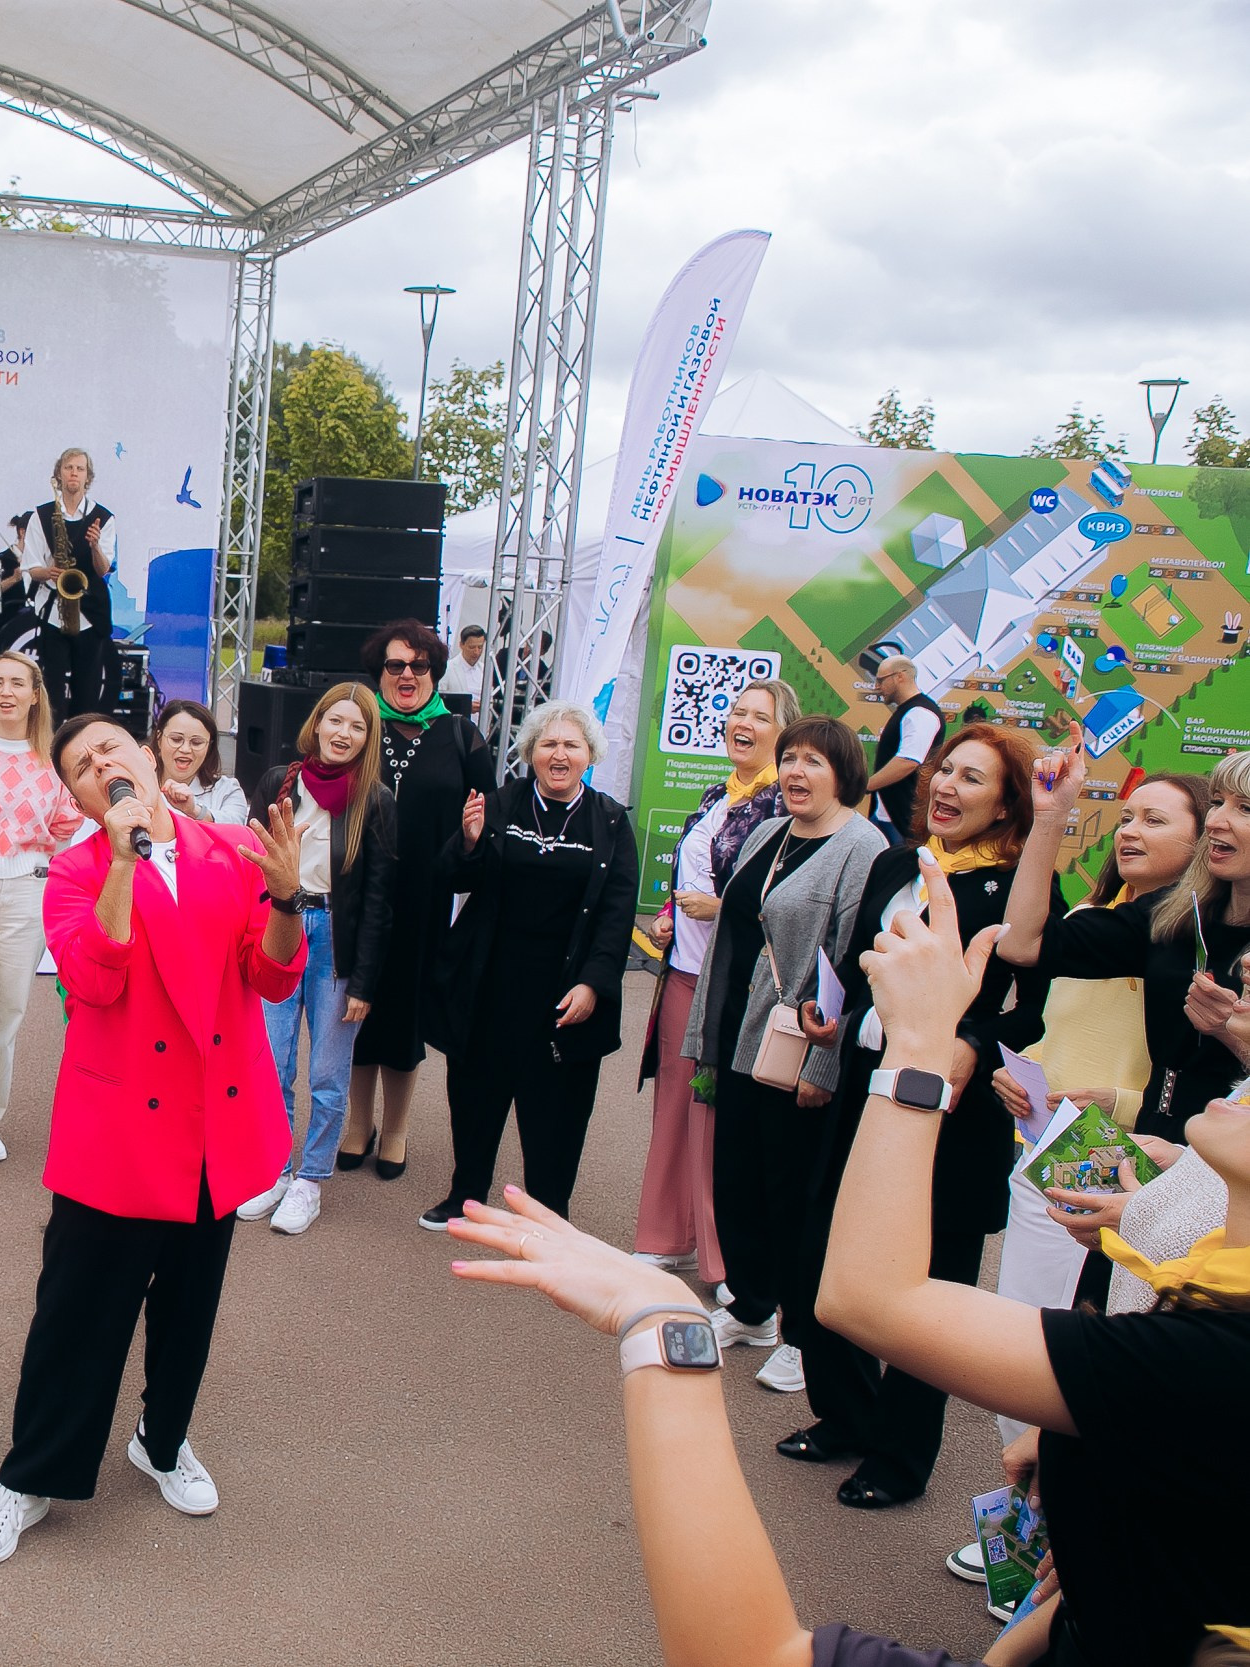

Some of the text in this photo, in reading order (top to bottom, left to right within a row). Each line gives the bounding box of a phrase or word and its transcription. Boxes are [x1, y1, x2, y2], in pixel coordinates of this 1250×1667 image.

[639, 297, 721, 521] НЕФТЯНОЙ И ГАЗОВОЙ
[631, 324, 700, 517] ДЕНЬ РАБОТНИКОВ
[738, 487, 839, 506] НОВАТЭК
[849, 495, 874, 506] лет
[1032, 495, 1056, 508] WC
[1087, 521, 1125, 533] КВИЗ
[1102, 718, 1135, 743] СЦЕНА
[1193, 726, 1250, 737] НАПИТКАМИ
